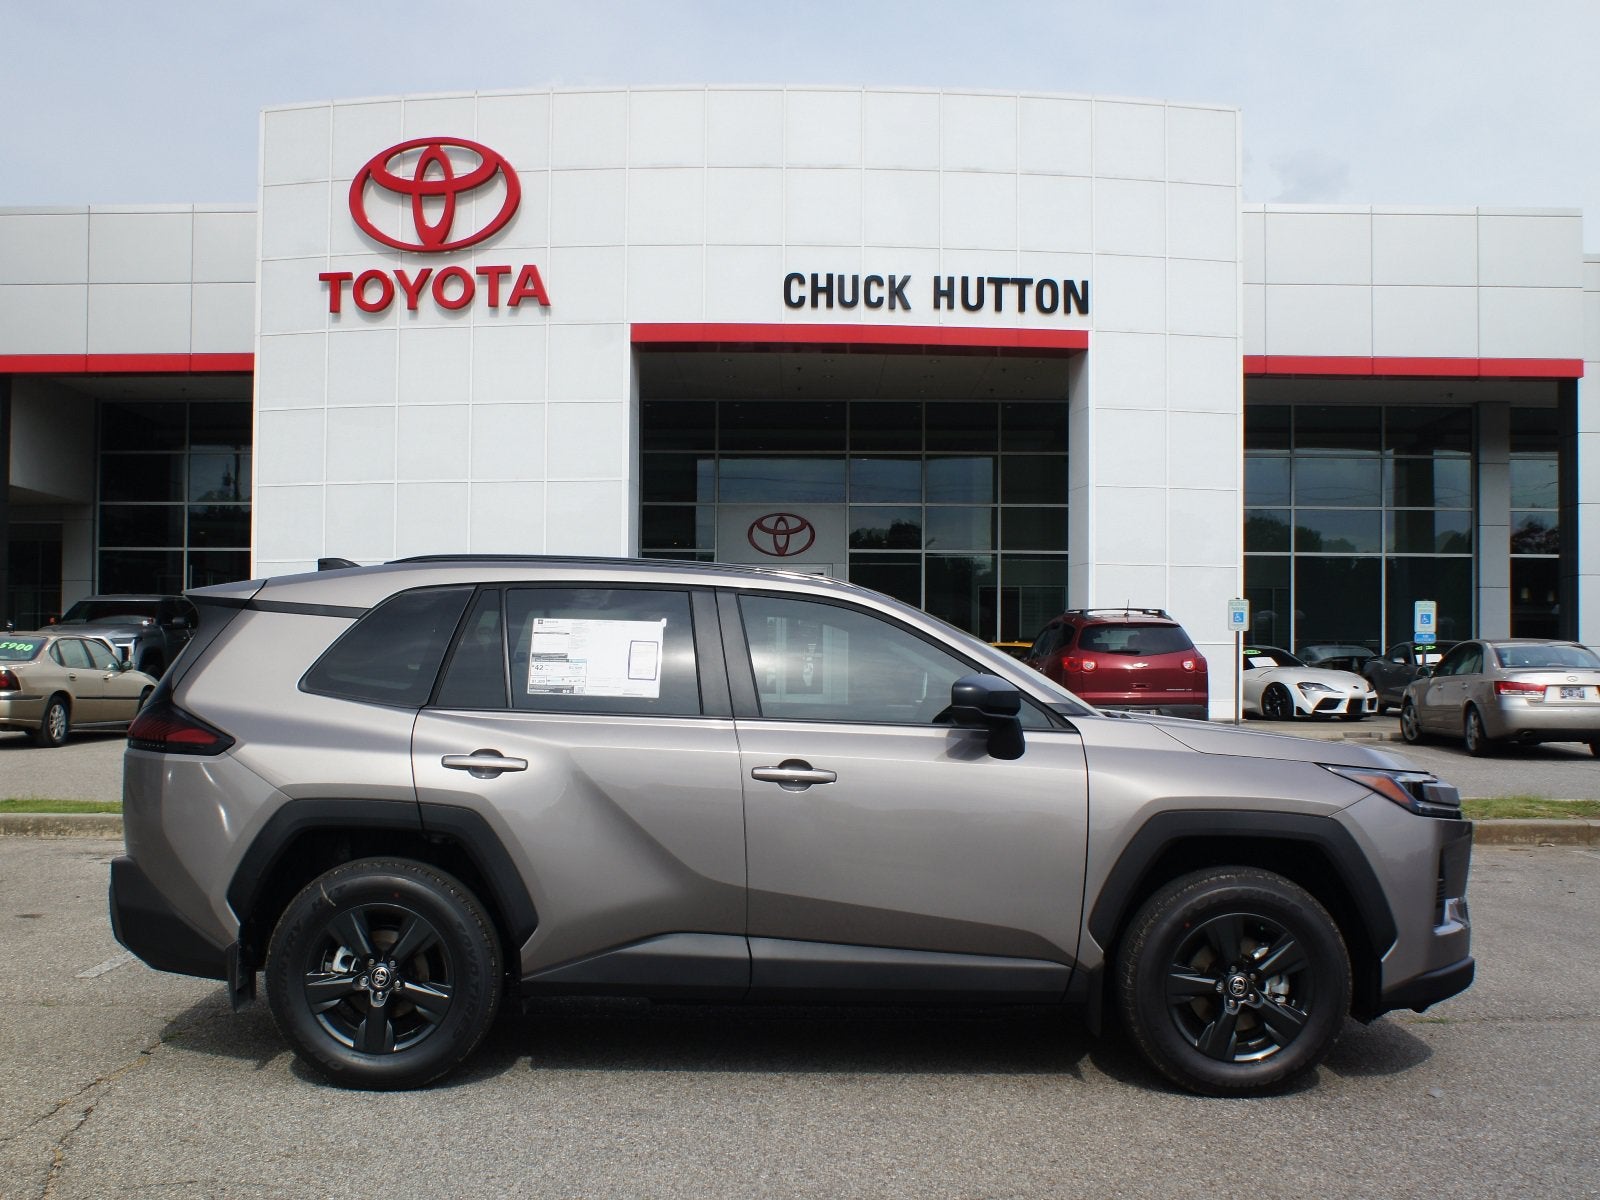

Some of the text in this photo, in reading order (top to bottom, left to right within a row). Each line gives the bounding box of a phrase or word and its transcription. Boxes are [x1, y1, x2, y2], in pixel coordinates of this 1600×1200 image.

[318, 264, 551, 313] TOYOTA
[783, 272, 1089, 315] CHUCK HUTTON
